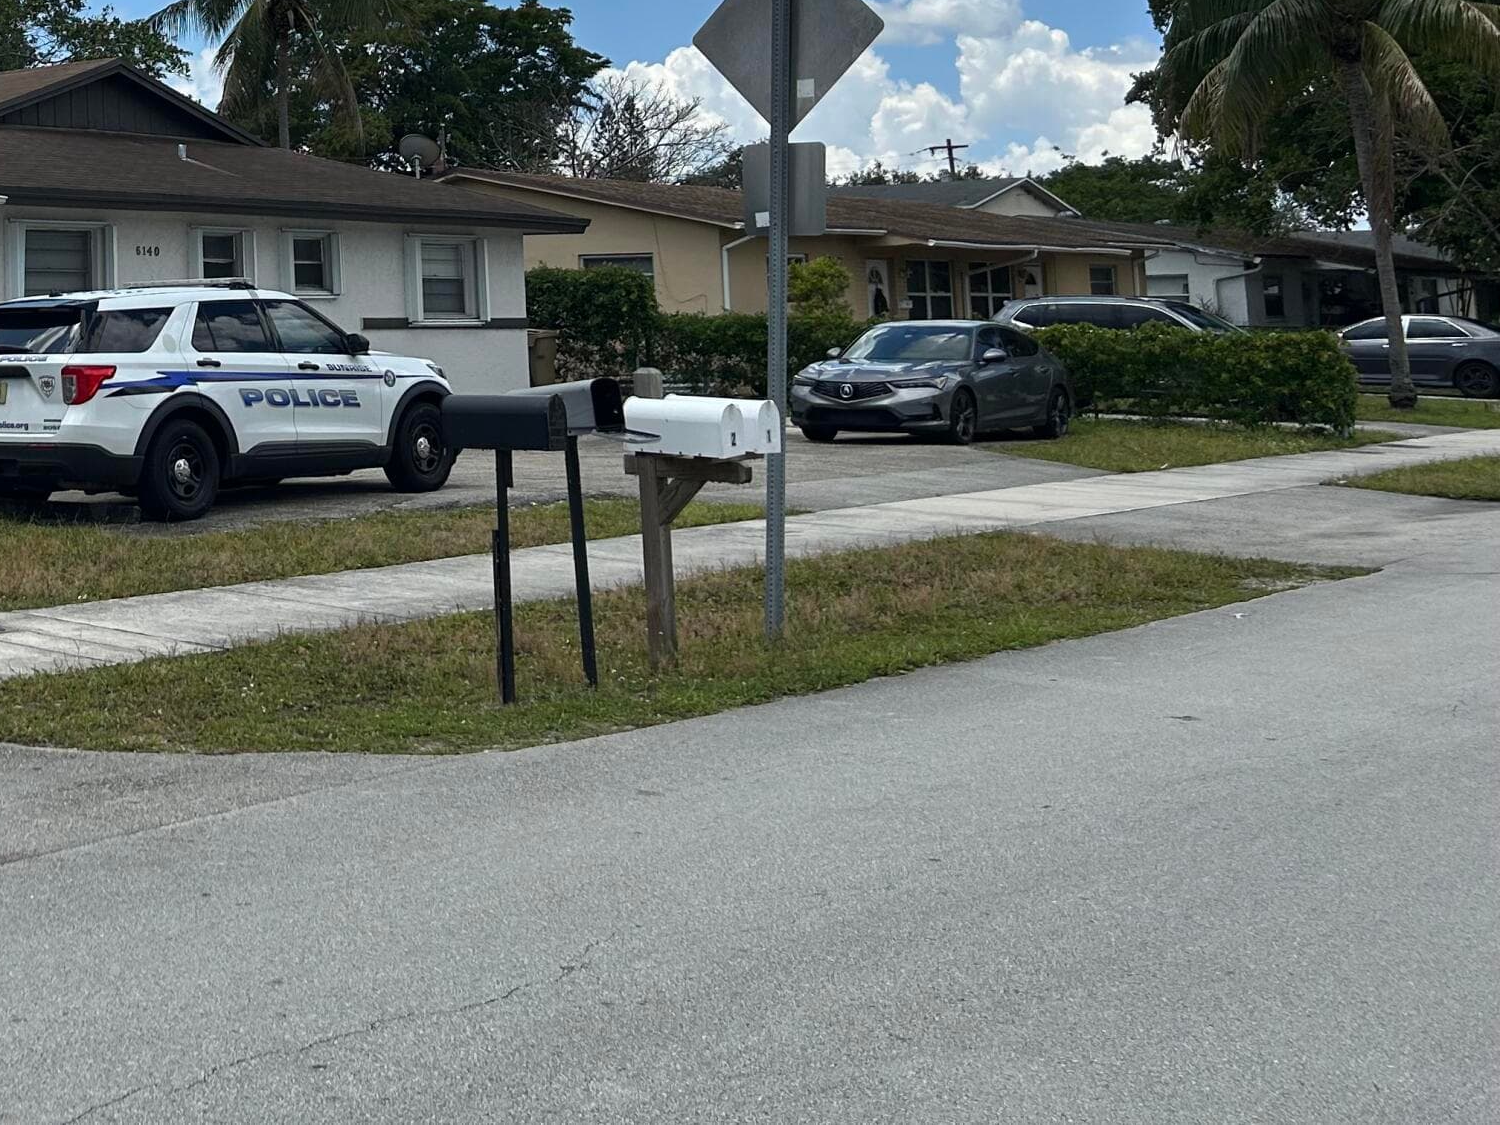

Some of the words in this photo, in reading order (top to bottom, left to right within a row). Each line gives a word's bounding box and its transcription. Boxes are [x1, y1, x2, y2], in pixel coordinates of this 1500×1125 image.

[135, 245, 160, 256] 6140
[0, 355, 49, 363] POLICE
[326, 363, 373, 373] SUNRISE
[239, 388, 361, 408] POLICE
[731, 432, 737, 446] 2
[766, 429, 772, 443] 1
